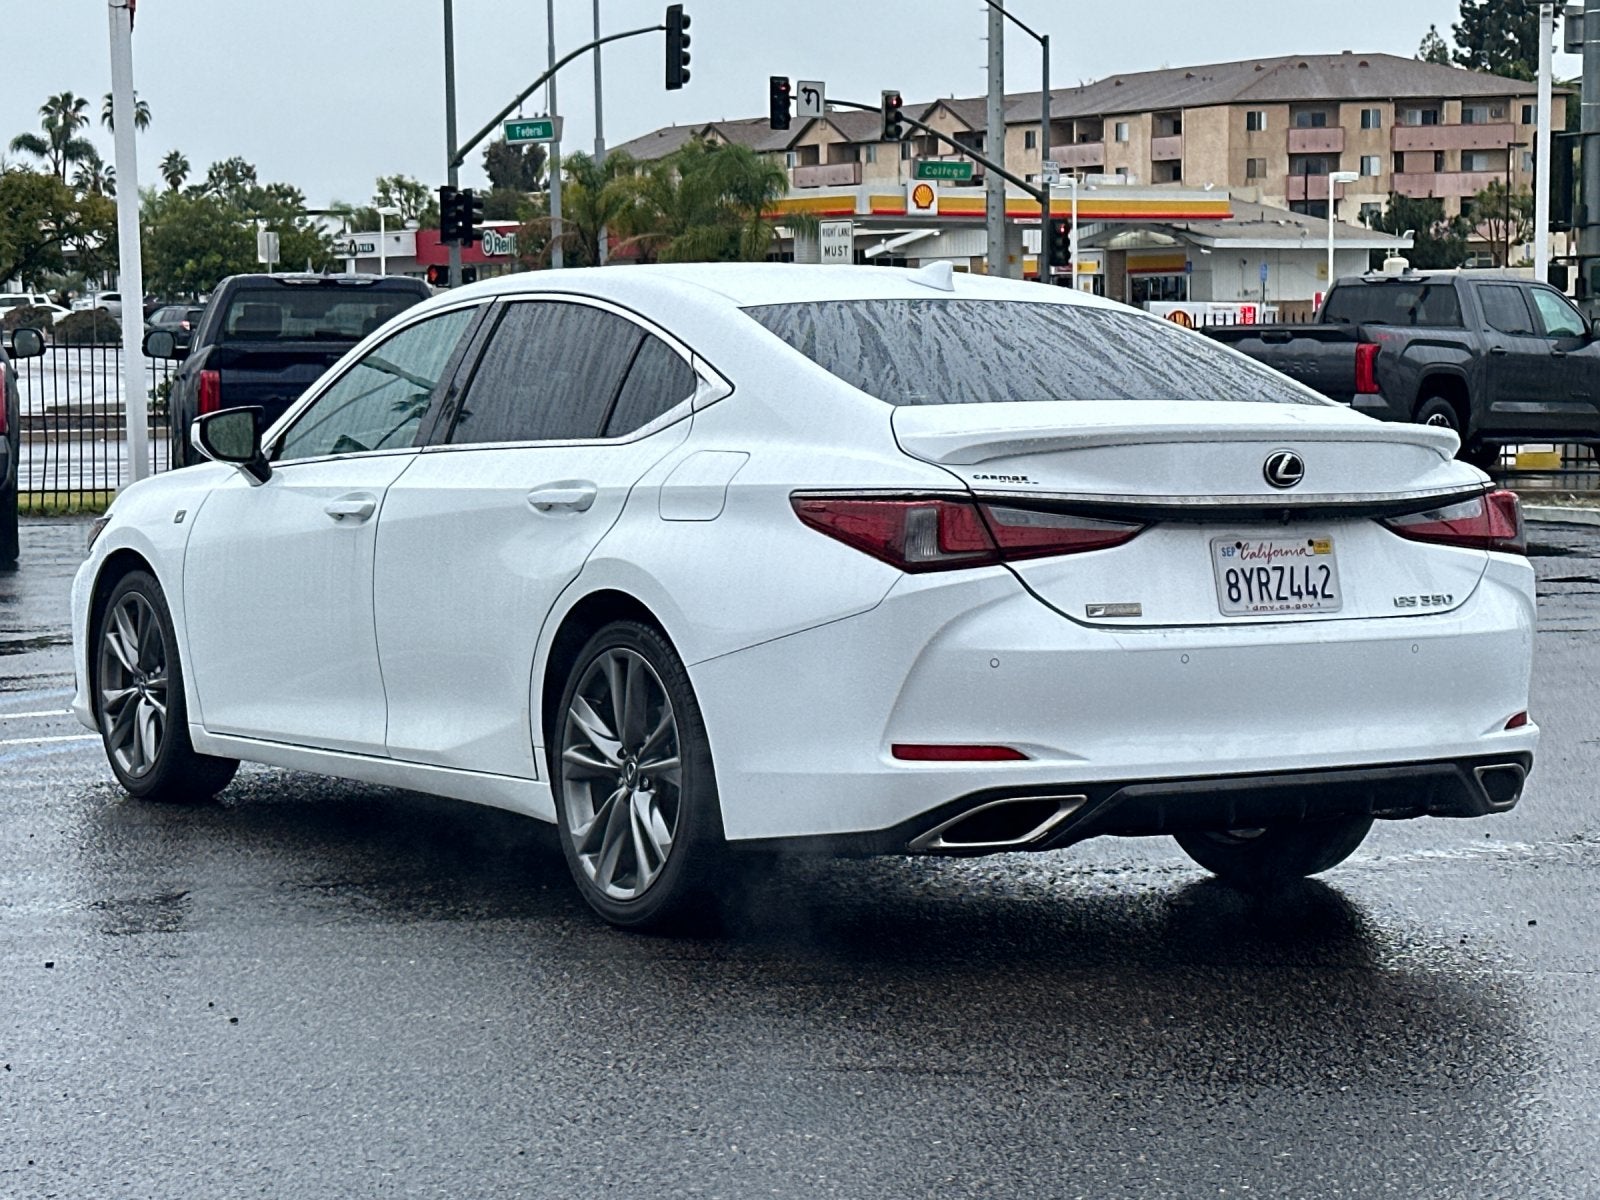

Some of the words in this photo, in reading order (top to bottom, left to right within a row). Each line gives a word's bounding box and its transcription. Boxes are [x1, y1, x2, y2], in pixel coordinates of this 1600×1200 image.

[515, 125, 543, 137] Federal
[925, 166, 965, 178] College
[824, 245, 848, 257] MUST
[1221, 547, 1236, 557] SEP
[1240, 542, 1315, 564] California
[1225, 564, 1334, 603] 8YRZ442
[1419, 594, 1453, 606] 350
[1252, 602, 1314, 611] dmv.ca.gov
